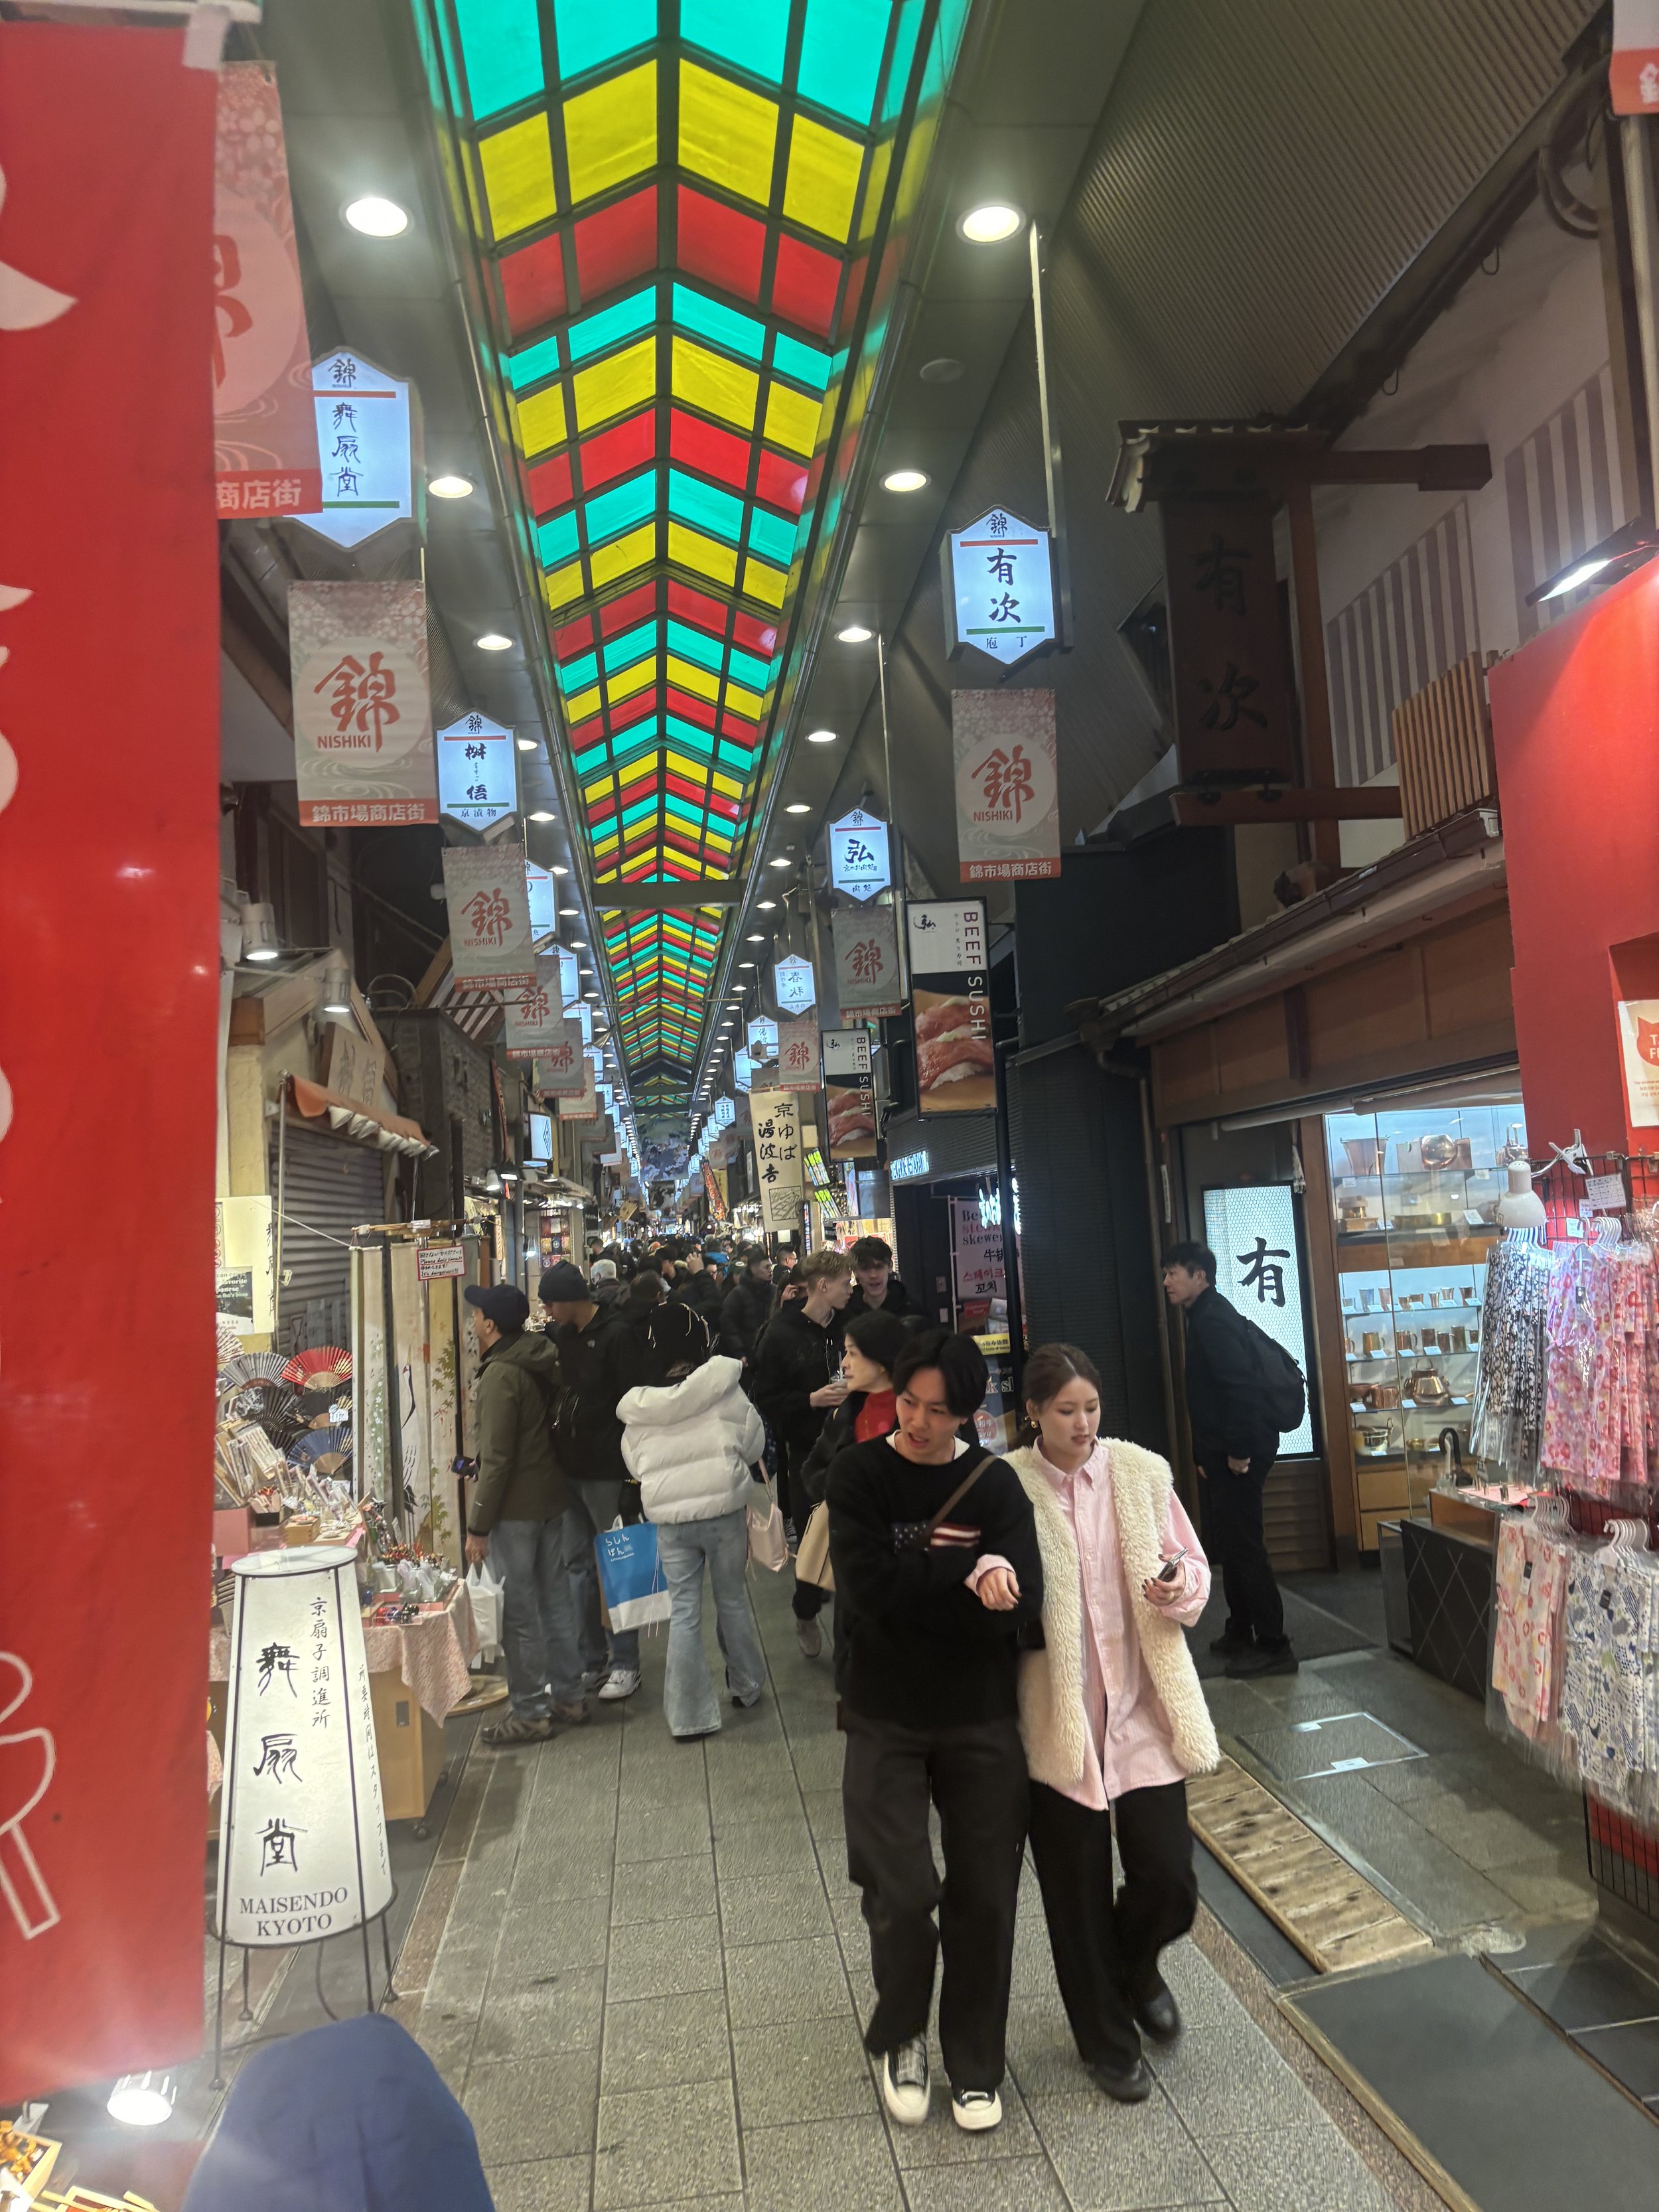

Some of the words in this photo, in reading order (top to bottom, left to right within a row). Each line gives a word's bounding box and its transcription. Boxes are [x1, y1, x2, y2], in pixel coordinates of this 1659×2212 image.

[328, 358, 363, 388] 錦
[329, 402, 364, 497] 舞扇堂
[986, 513, 1008, 538] 錦
[987, 548, 1021, 624] 有次
[986, 636, 1027, 650] 庖丁
[1189, 533, 1268, 731] 有次
[314, 648, 400, 753] 錦
[317, 735, 371, 749] NISHIKI
[466, 715, 482, 734] 錦
[971, 745, 1035, 824] 錦
[312, 803, 425, 823] 錦市場商店街
[850, 810, 863, 826] 錦
[974, 810, 1013, 822] NISHIKI
[844, 838, 875, 863] 弘
[970, 863, 1052, 878] 錦市場商店街
[461, 887, 514, 947] 錦
[465, 936, 496, 946] NISHIKI
[964, 912, 981, 964] BEEF
[845, 938, 883, 985] 錦
[515, 986, 550, 1027] 錦
[968, 976, 986, 1039] SUSHI
[784, 1041, 810, 1070] 錦
[857, 1037, 867, 1069] BEEF
[859, 1076, 871, 1115] SUSHI
[774, 1103, 798, 1161] 京ゆば
[1236, 1236, 1291, 1307] 有
[309, 1596, 332, 1729] 京扇子調進所
[253, 1641, 308, 1877] 舞扇堂
[240, 1886, 348, 1915] MAISENDO
[256, 1913, 332, 1937] KYOTO
